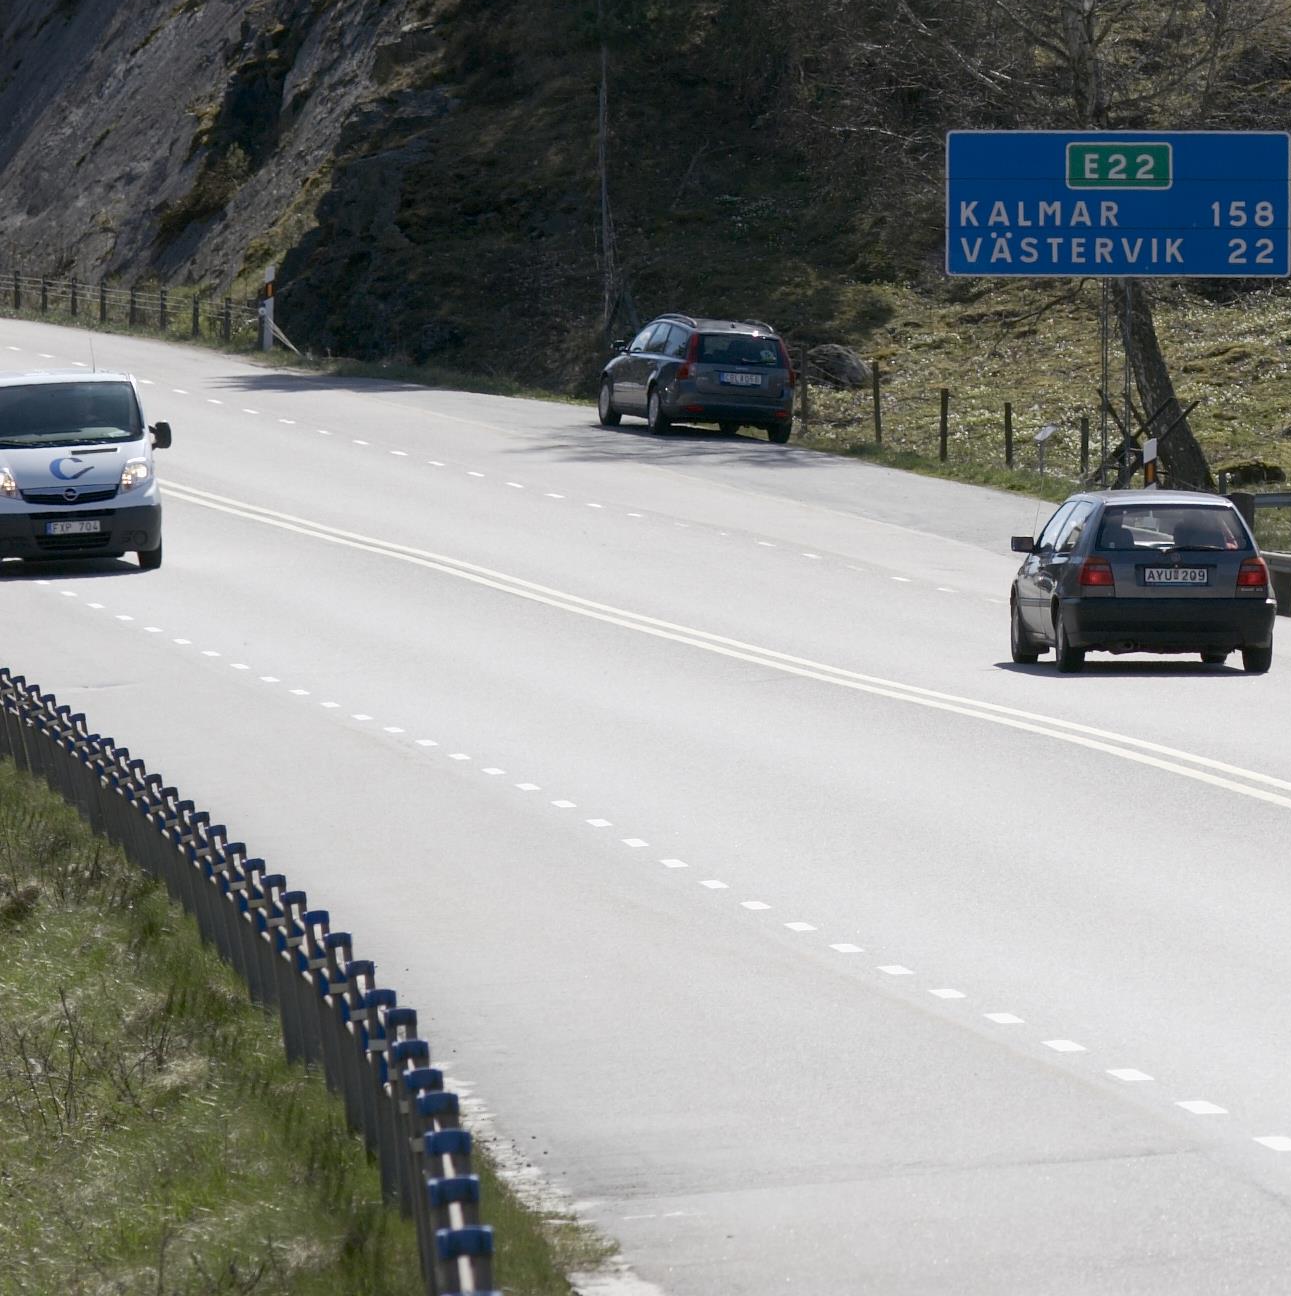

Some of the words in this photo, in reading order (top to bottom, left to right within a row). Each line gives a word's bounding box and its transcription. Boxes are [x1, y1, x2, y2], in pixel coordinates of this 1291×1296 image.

[1084, 154, 1154, 179] E22
[960, 201, 1119, 227] KALMAR
[1211, 201, 1274, 227] 158
[960, 232, 1184, 263] VÄSTERVIK
[1228, 238, 1274, 264] 22
[1147, 570, 1173, 581] AYU
[1182, 570, 1205, 581] 209
